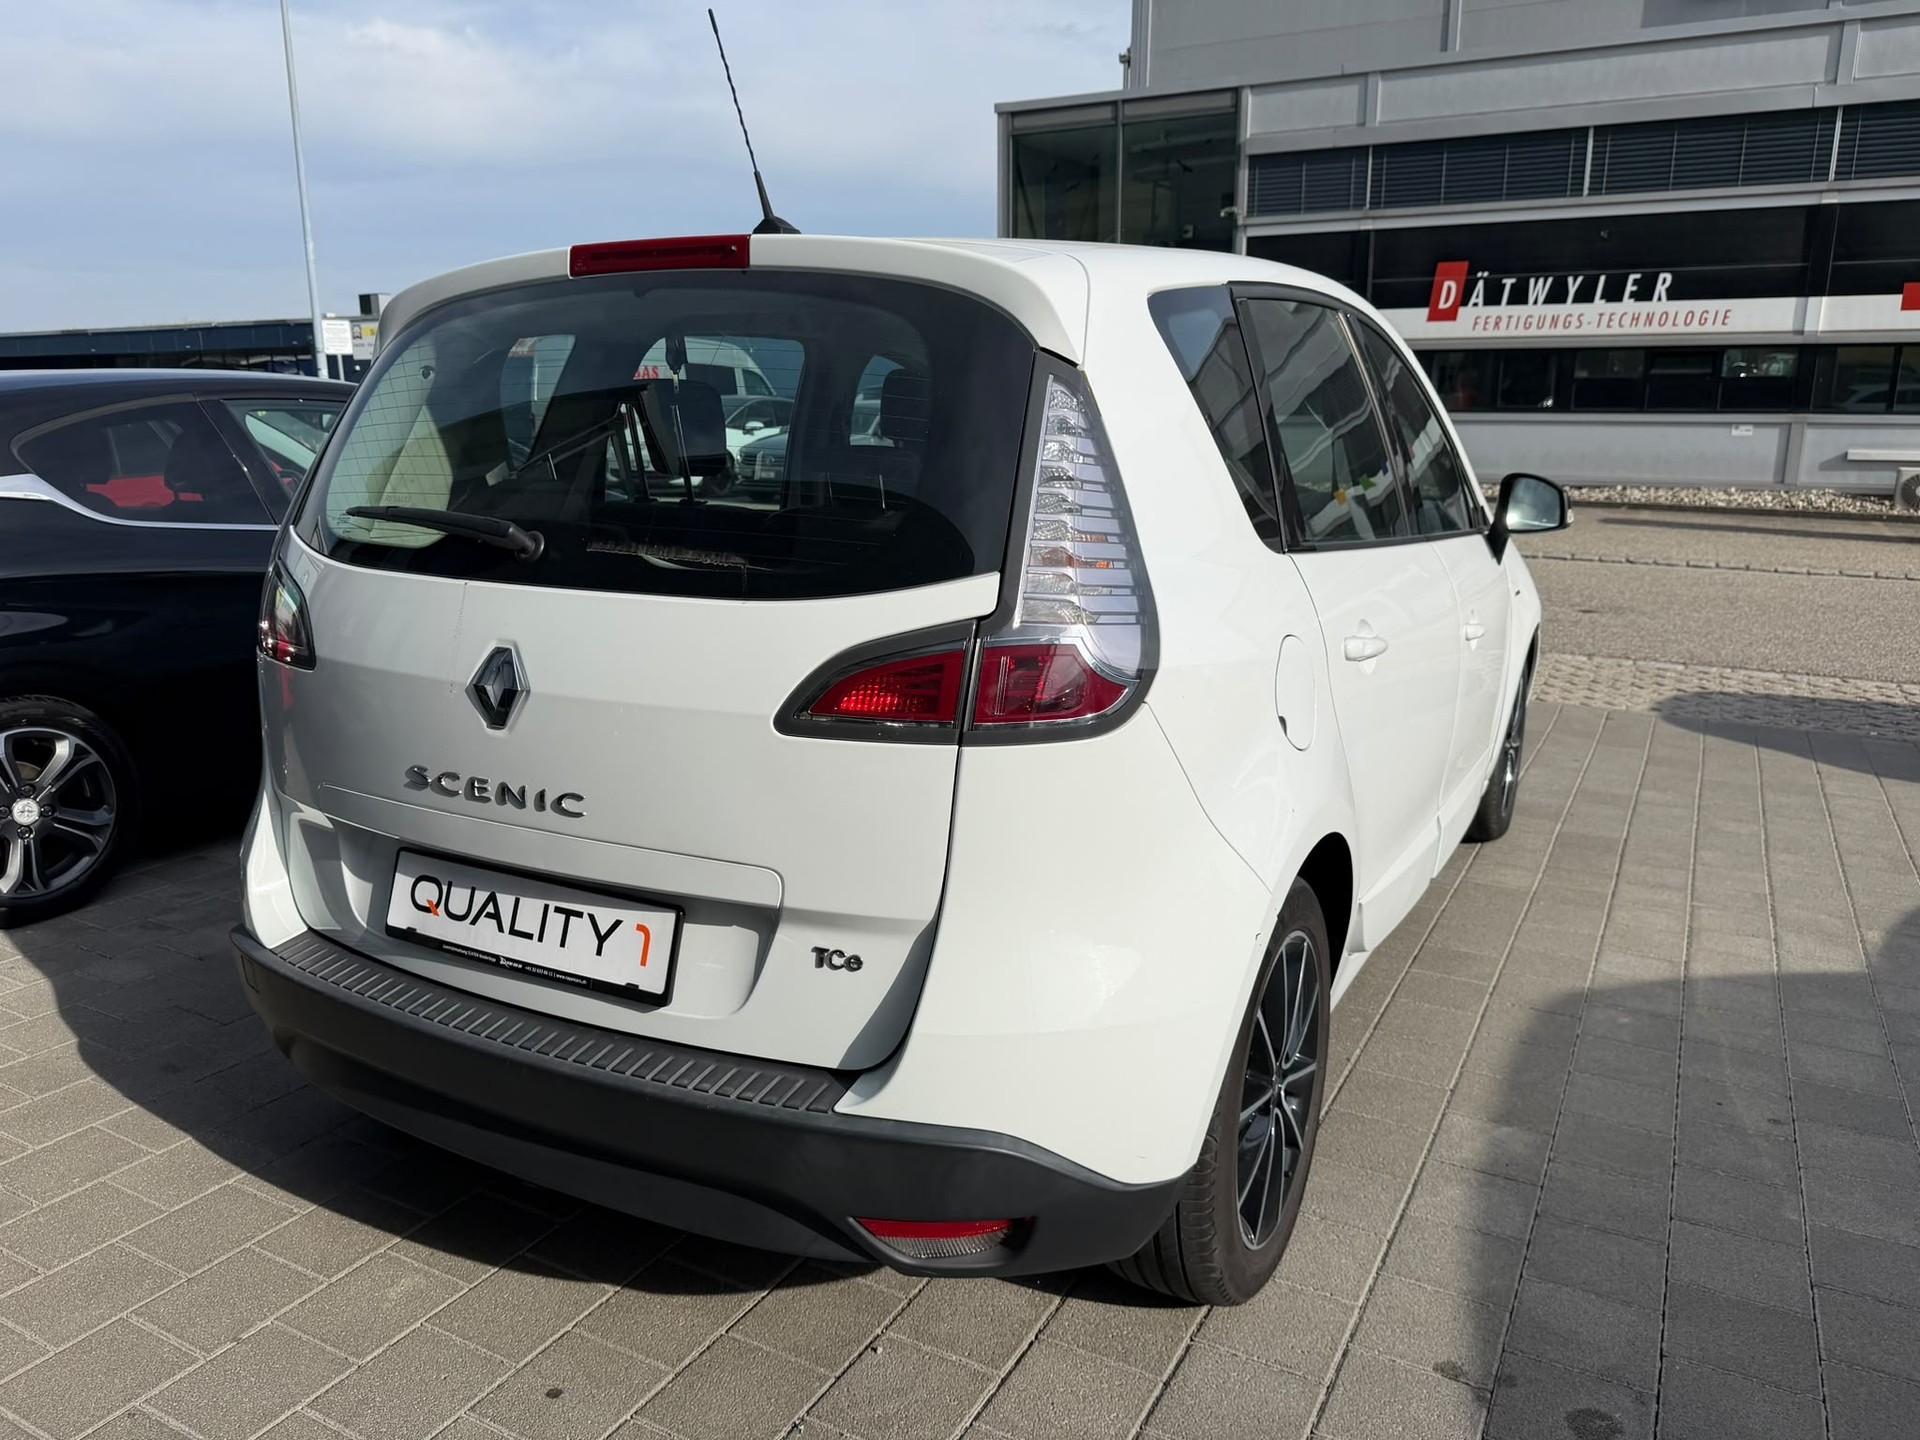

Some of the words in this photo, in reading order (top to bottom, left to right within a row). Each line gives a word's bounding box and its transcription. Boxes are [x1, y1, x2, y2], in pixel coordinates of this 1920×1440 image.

[1438, 271, 1673, 310] DÄTWYLER
[1472, 308, 1733, 332] FERTIGUNGS-TECHNOLOGIE
[403, 764, 588, 819] SCENIC
[810, 945, 864, 973] TCe
